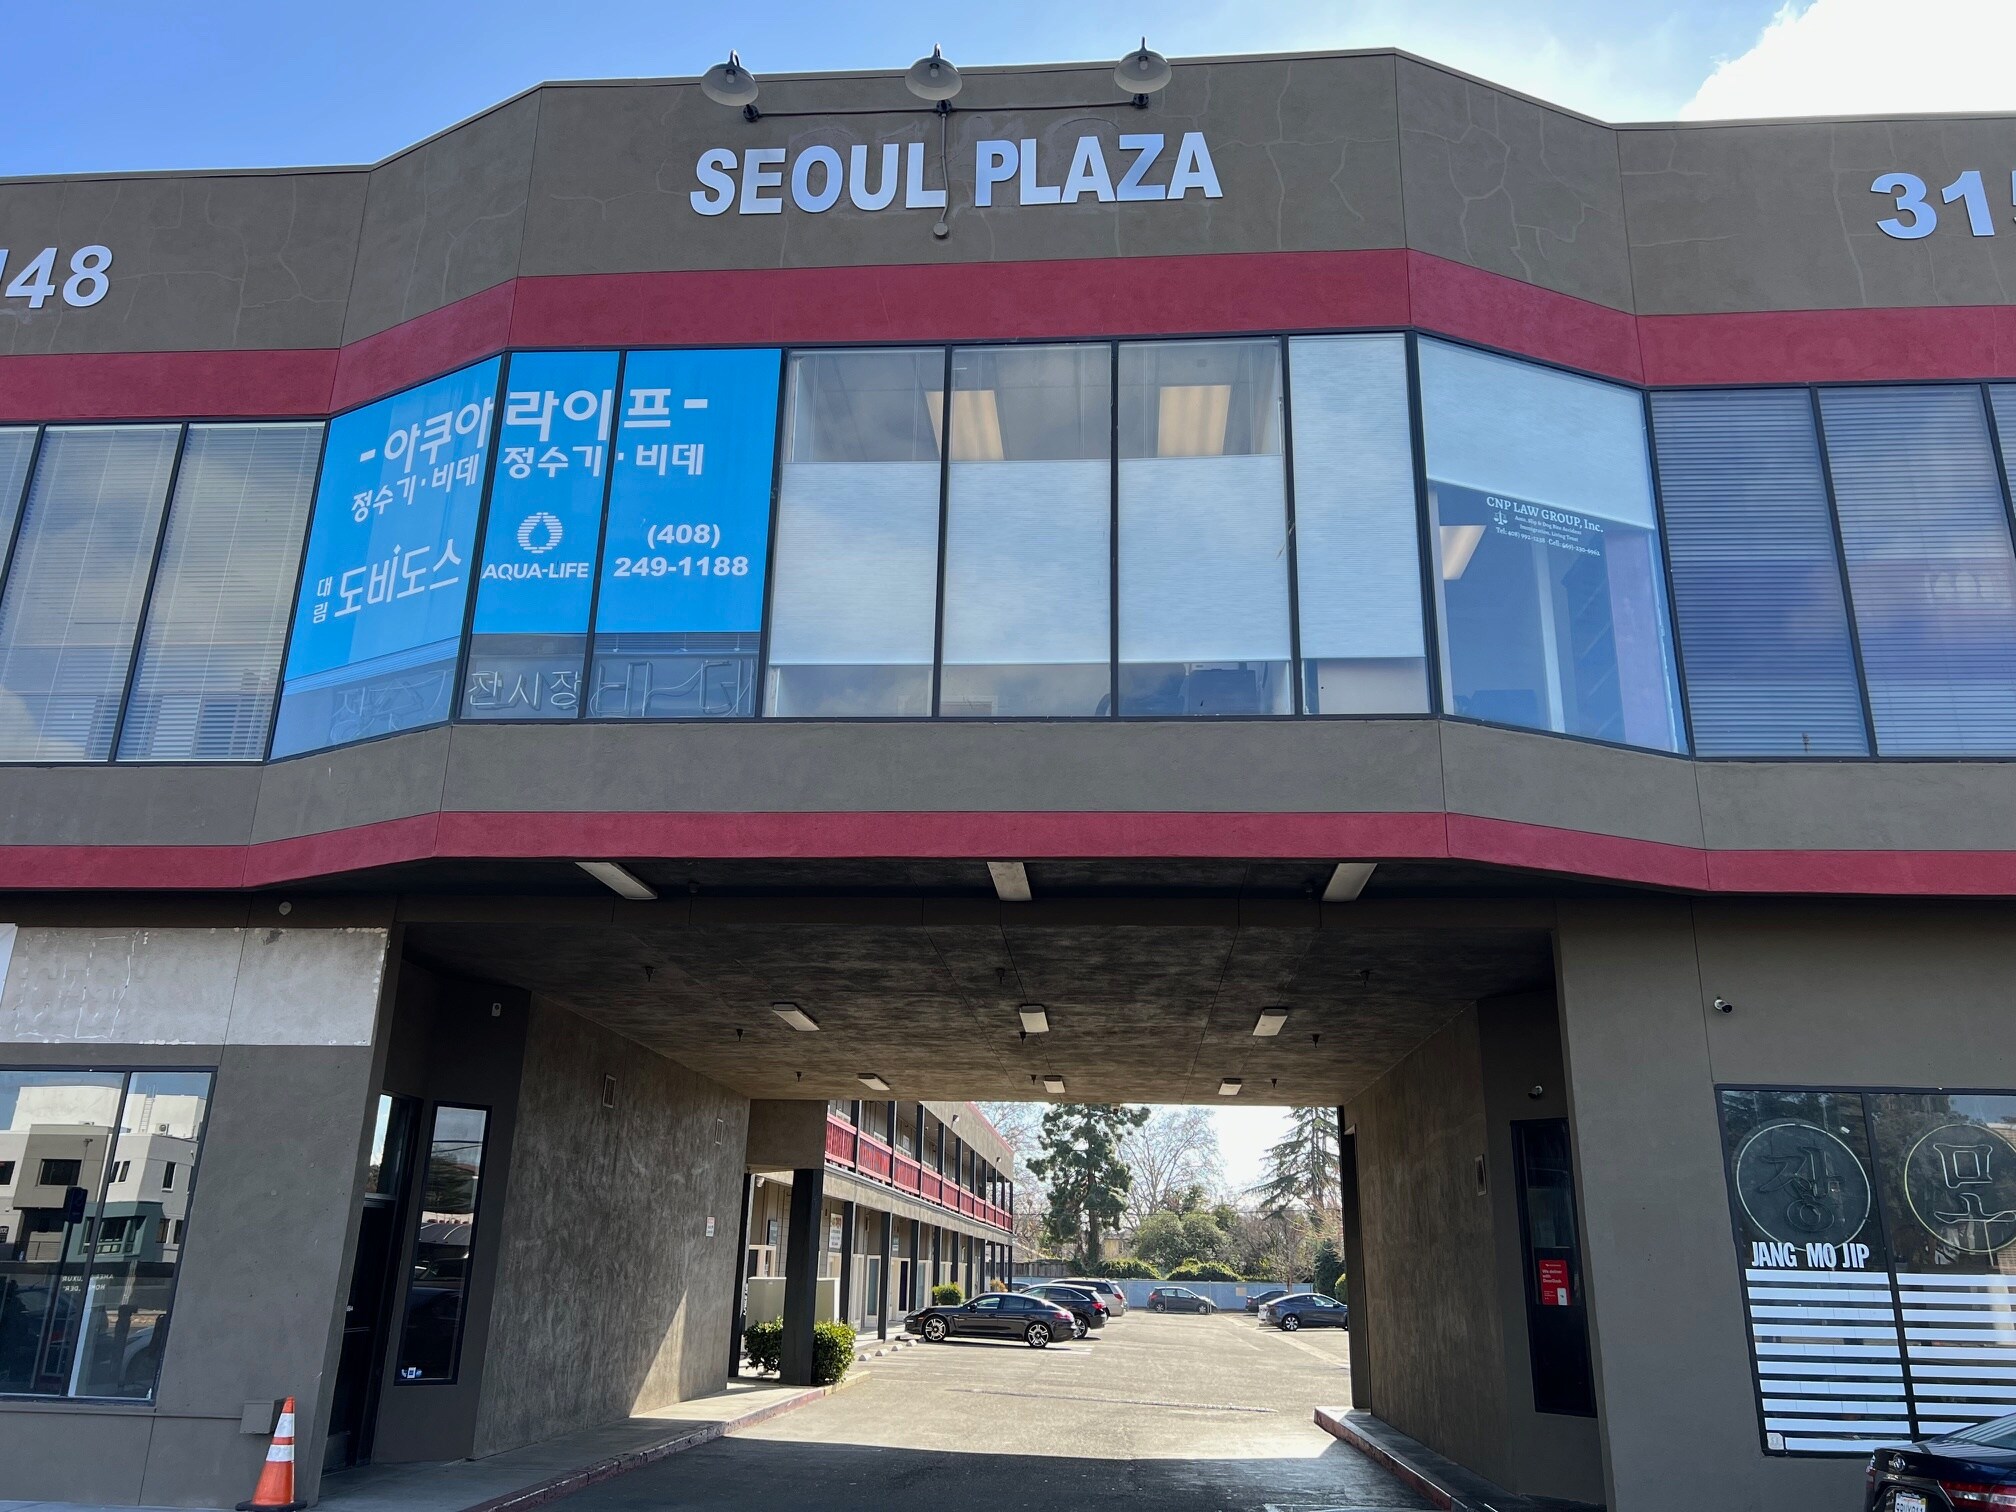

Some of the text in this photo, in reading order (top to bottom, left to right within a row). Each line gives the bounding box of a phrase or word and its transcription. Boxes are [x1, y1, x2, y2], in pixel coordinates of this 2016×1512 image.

[690, 132, 1223, 216] SEOUL PLAZA
[1870, 170, 2016, 240] 31
[0, 245, 113, 309] 48
[1486, 496, 1511, 510] CNP
[1513, 502, 1539, 517] LAW
[1583, 519, 1604, 533] Inc.
[647, 523, 721, 550] (408)
[481, 561, 590, 582] AQUA-LIFE
[613, 555, 749, 578] 249-1188
[1751, 1241, 1870, 1269] JANG MO JIP
